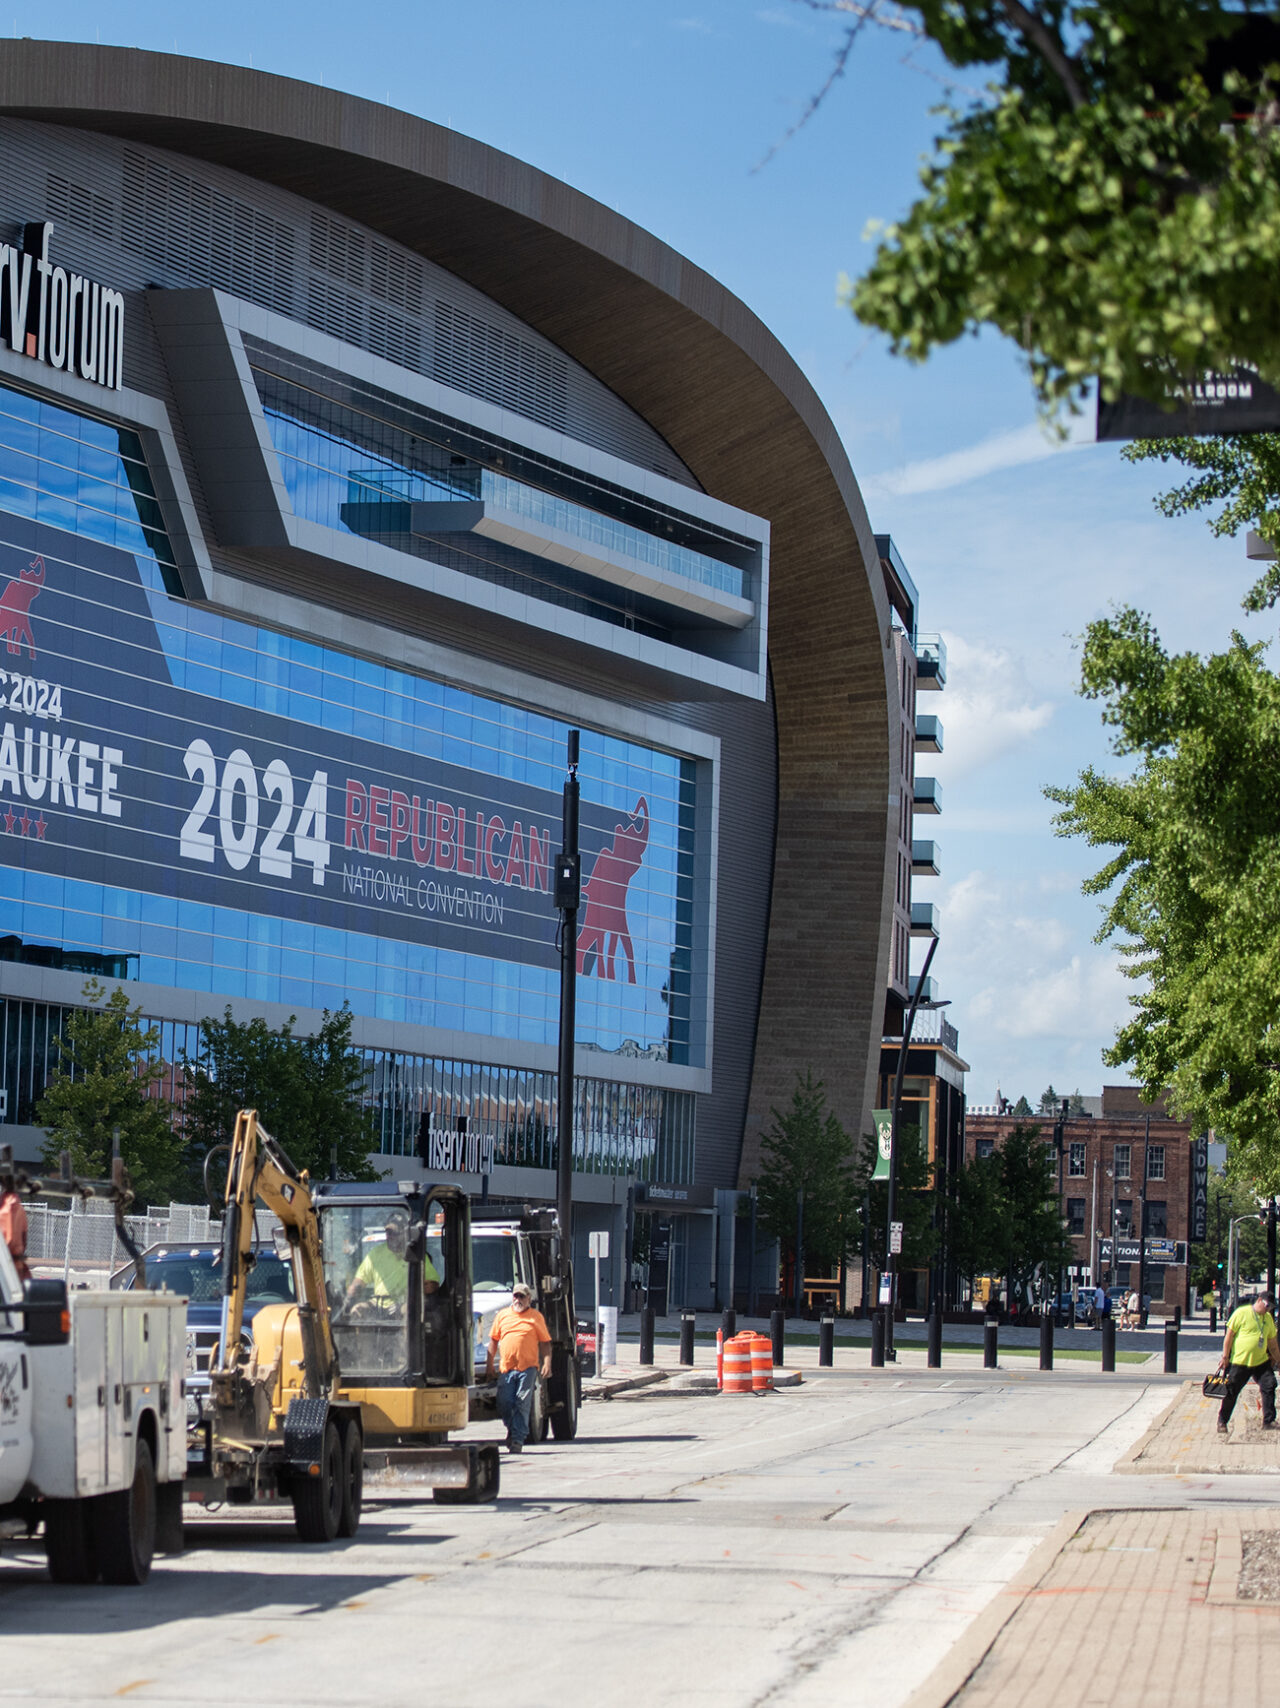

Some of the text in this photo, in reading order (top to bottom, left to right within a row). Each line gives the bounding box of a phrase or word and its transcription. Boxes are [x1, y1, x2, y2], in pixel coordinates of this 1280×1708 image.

[179, 738, 331, 886] 2024
[344, 778, 551, 894] REPUBLICAN
[343, 863, 503, 925] NATIONAL CONVENTION
[1102, 1246, 1151, 1256] NTIONL
